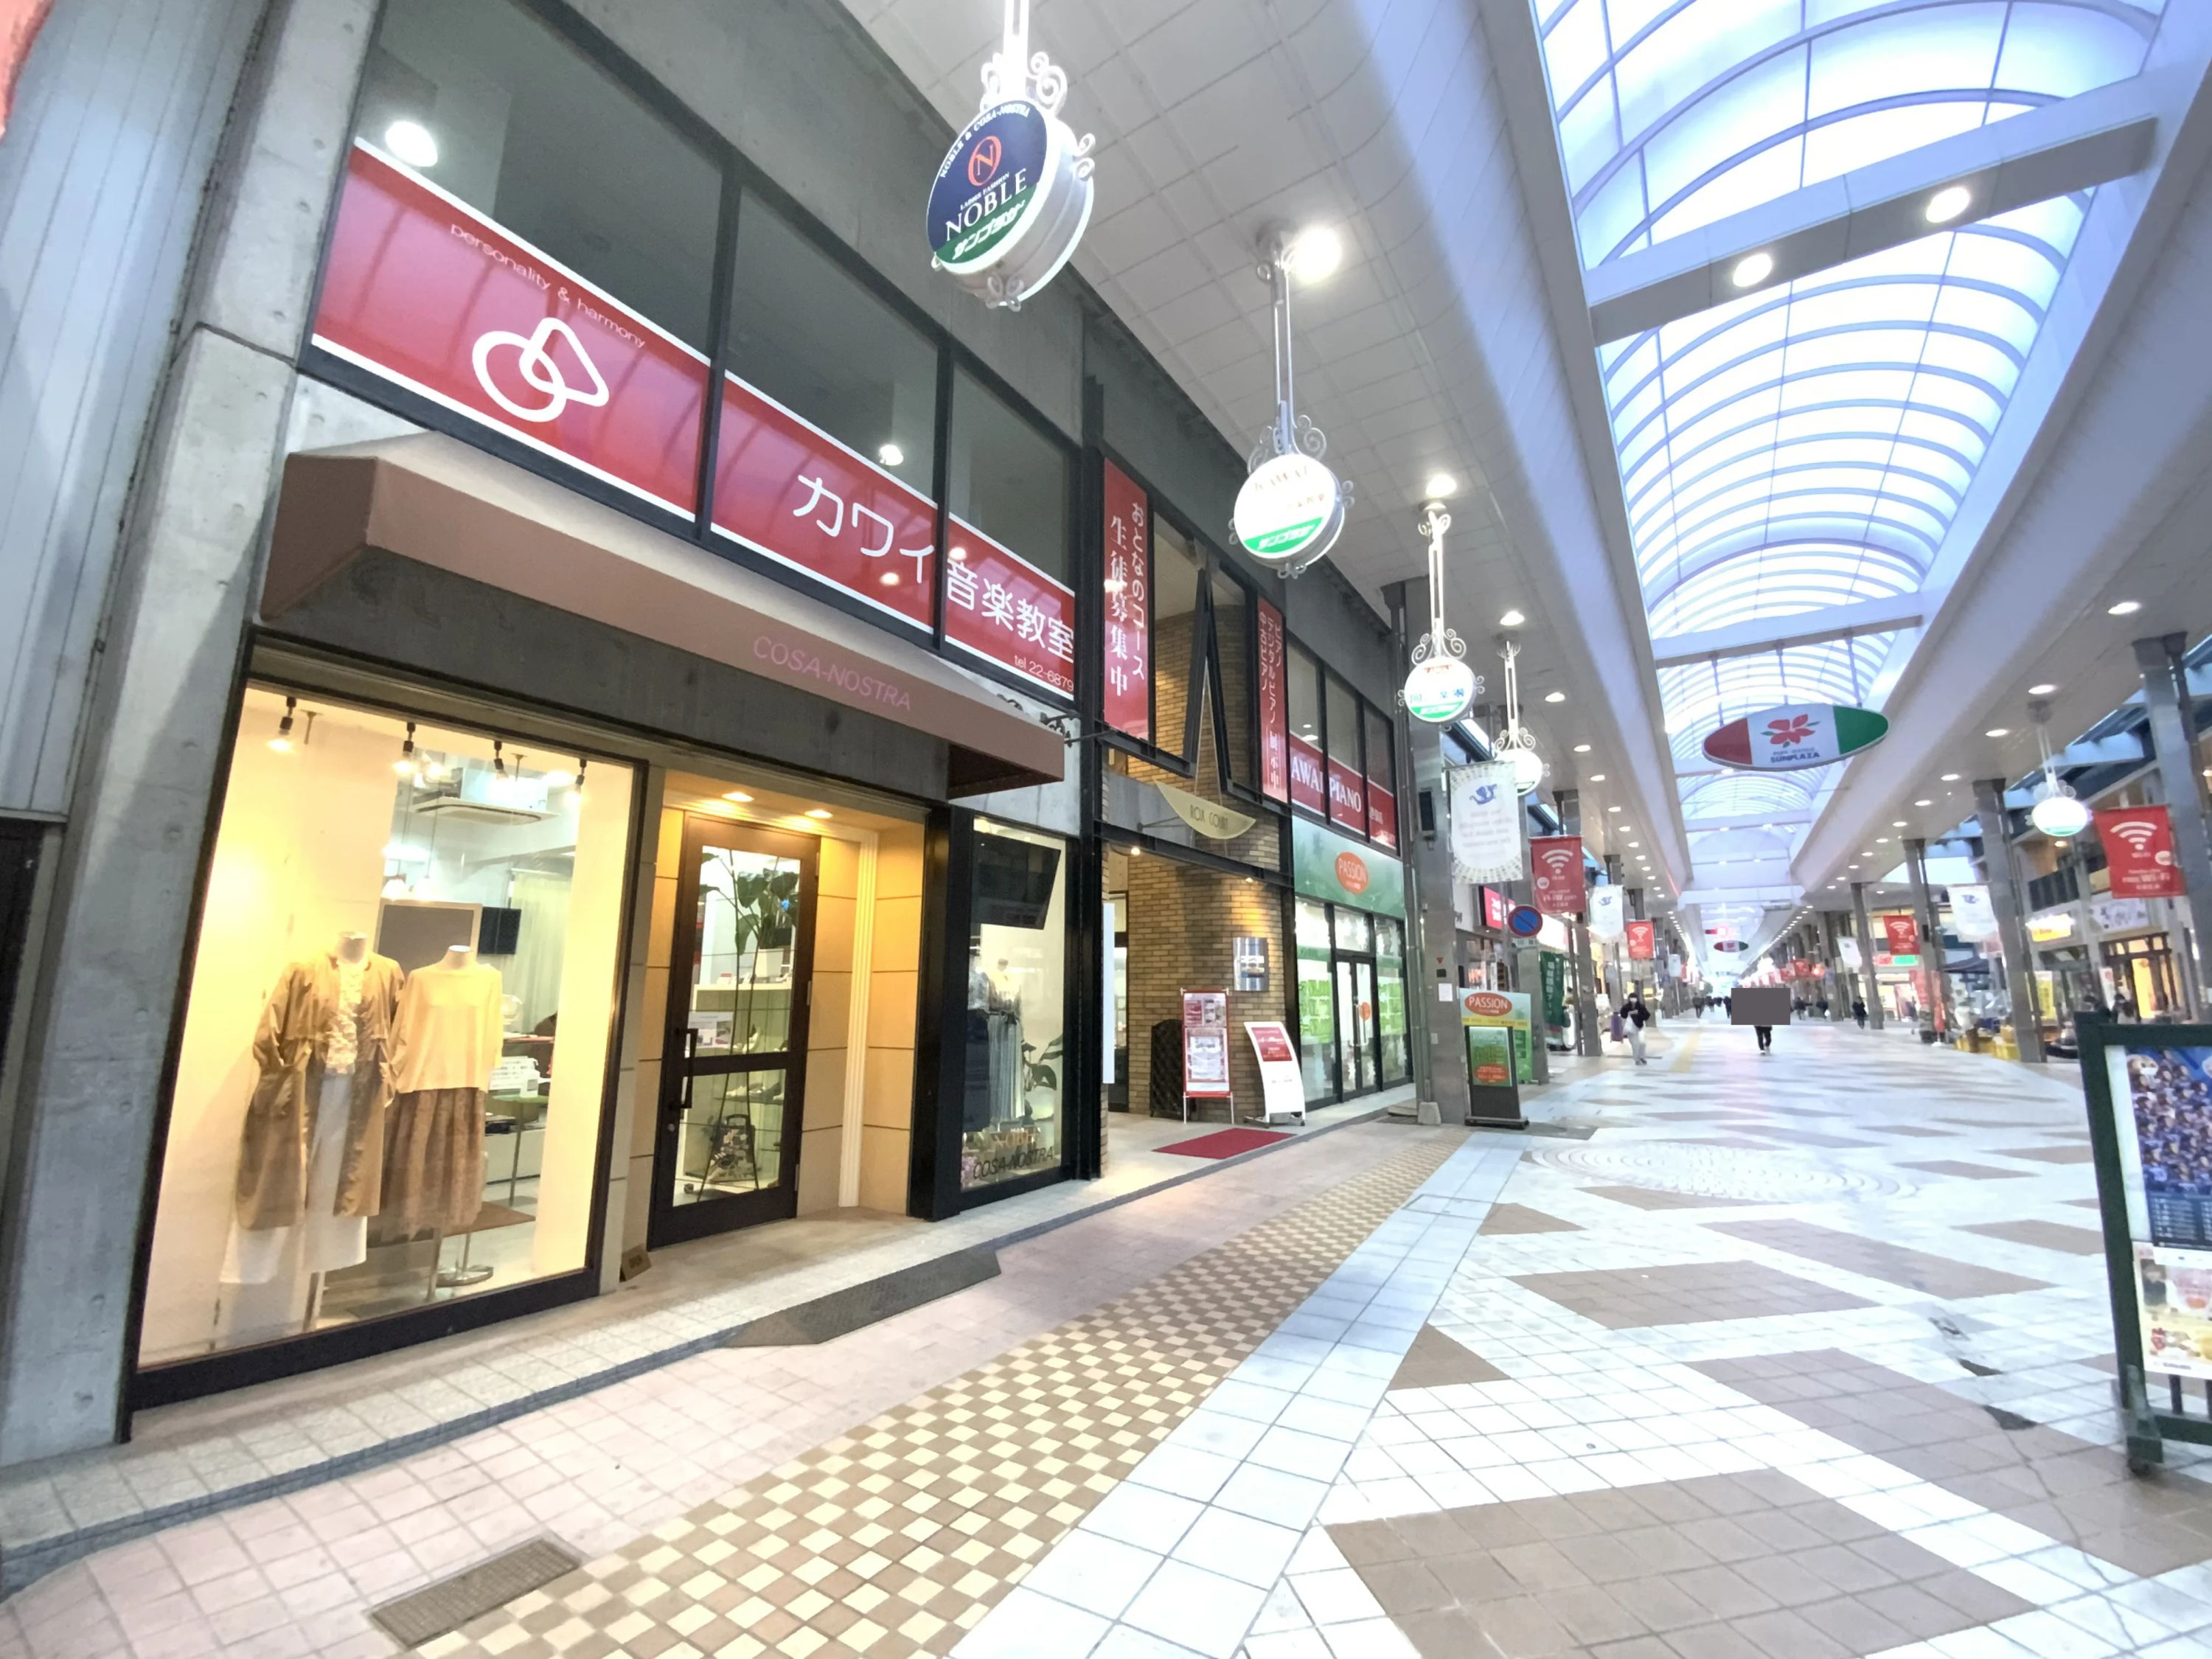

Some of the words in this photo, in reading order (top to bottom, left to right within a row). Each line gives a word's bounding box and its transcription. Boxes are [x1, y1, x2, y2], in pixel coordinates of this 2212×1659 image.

[945, 168, 1027, 241] NOBLE
[450, 223, 551, 291] personality
[557, 287, 571, 303] &
[578, 296, 646, 349] harmony
[793, 474, 935, 584] カワイ
[947, 559, 1075, 664] 音楽教室
[1132, 502, 1145, 680] おとなのコース
[754, 636, 911, 712] COSA-NOSTRA
[1014, 655, 1026, 669] tel
[1029, 661, 1074, 692] 22-6879
[1329, 776, 1362, 813] PIANO
[1338, 857, 1367, 882] PASSION
[1469, 996, 1508, 1009] PASSION
